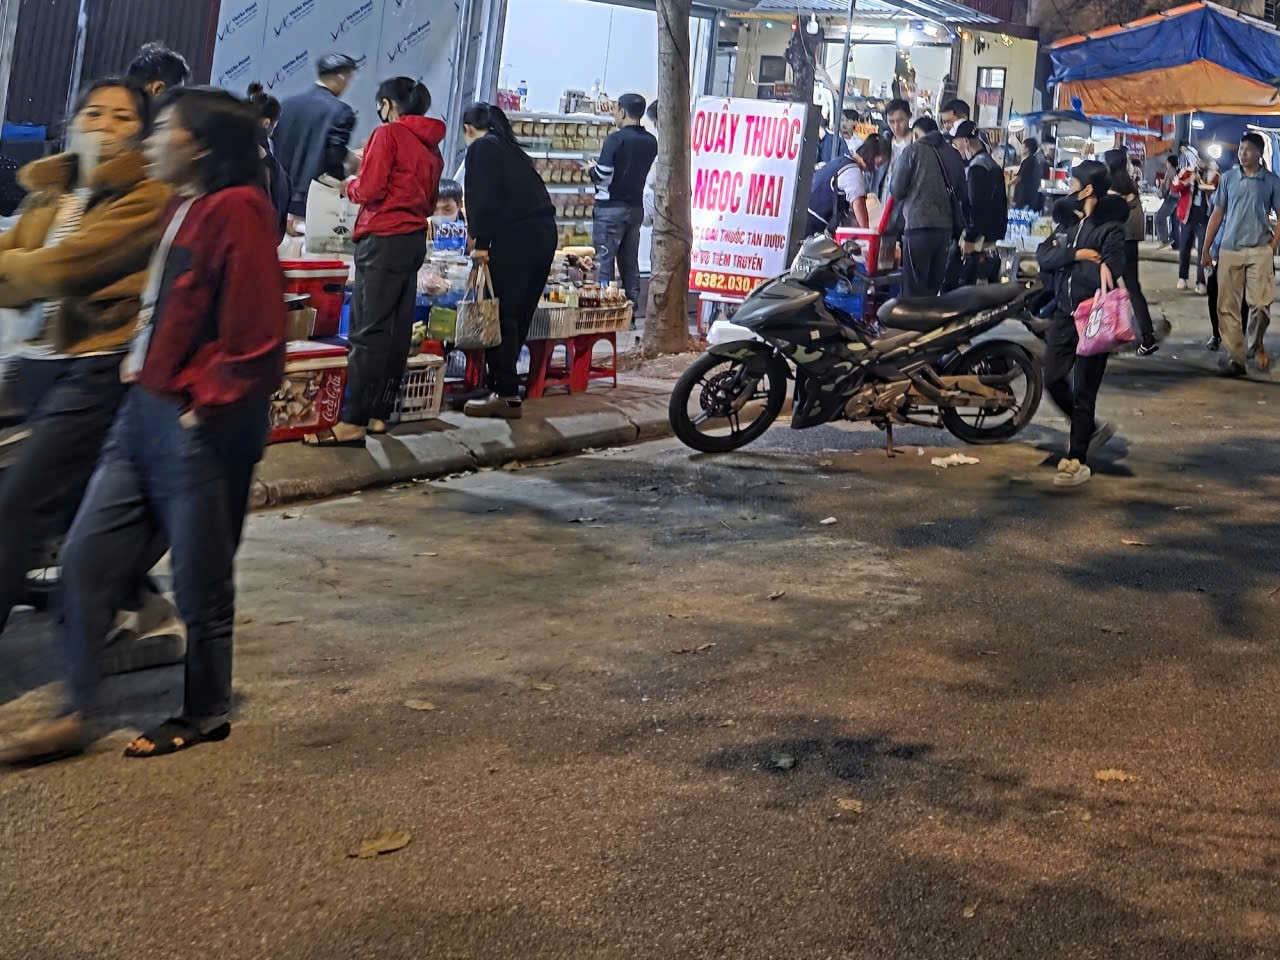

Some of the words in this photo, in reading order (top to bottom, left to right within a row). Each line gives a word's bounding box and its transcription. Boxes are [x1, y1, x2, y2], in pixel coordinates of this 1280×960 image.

[743, 103, 801, 161] THUỐC
[692, 168, 744, 221] NGỌC
[745, 172, 785, 218] MAI
